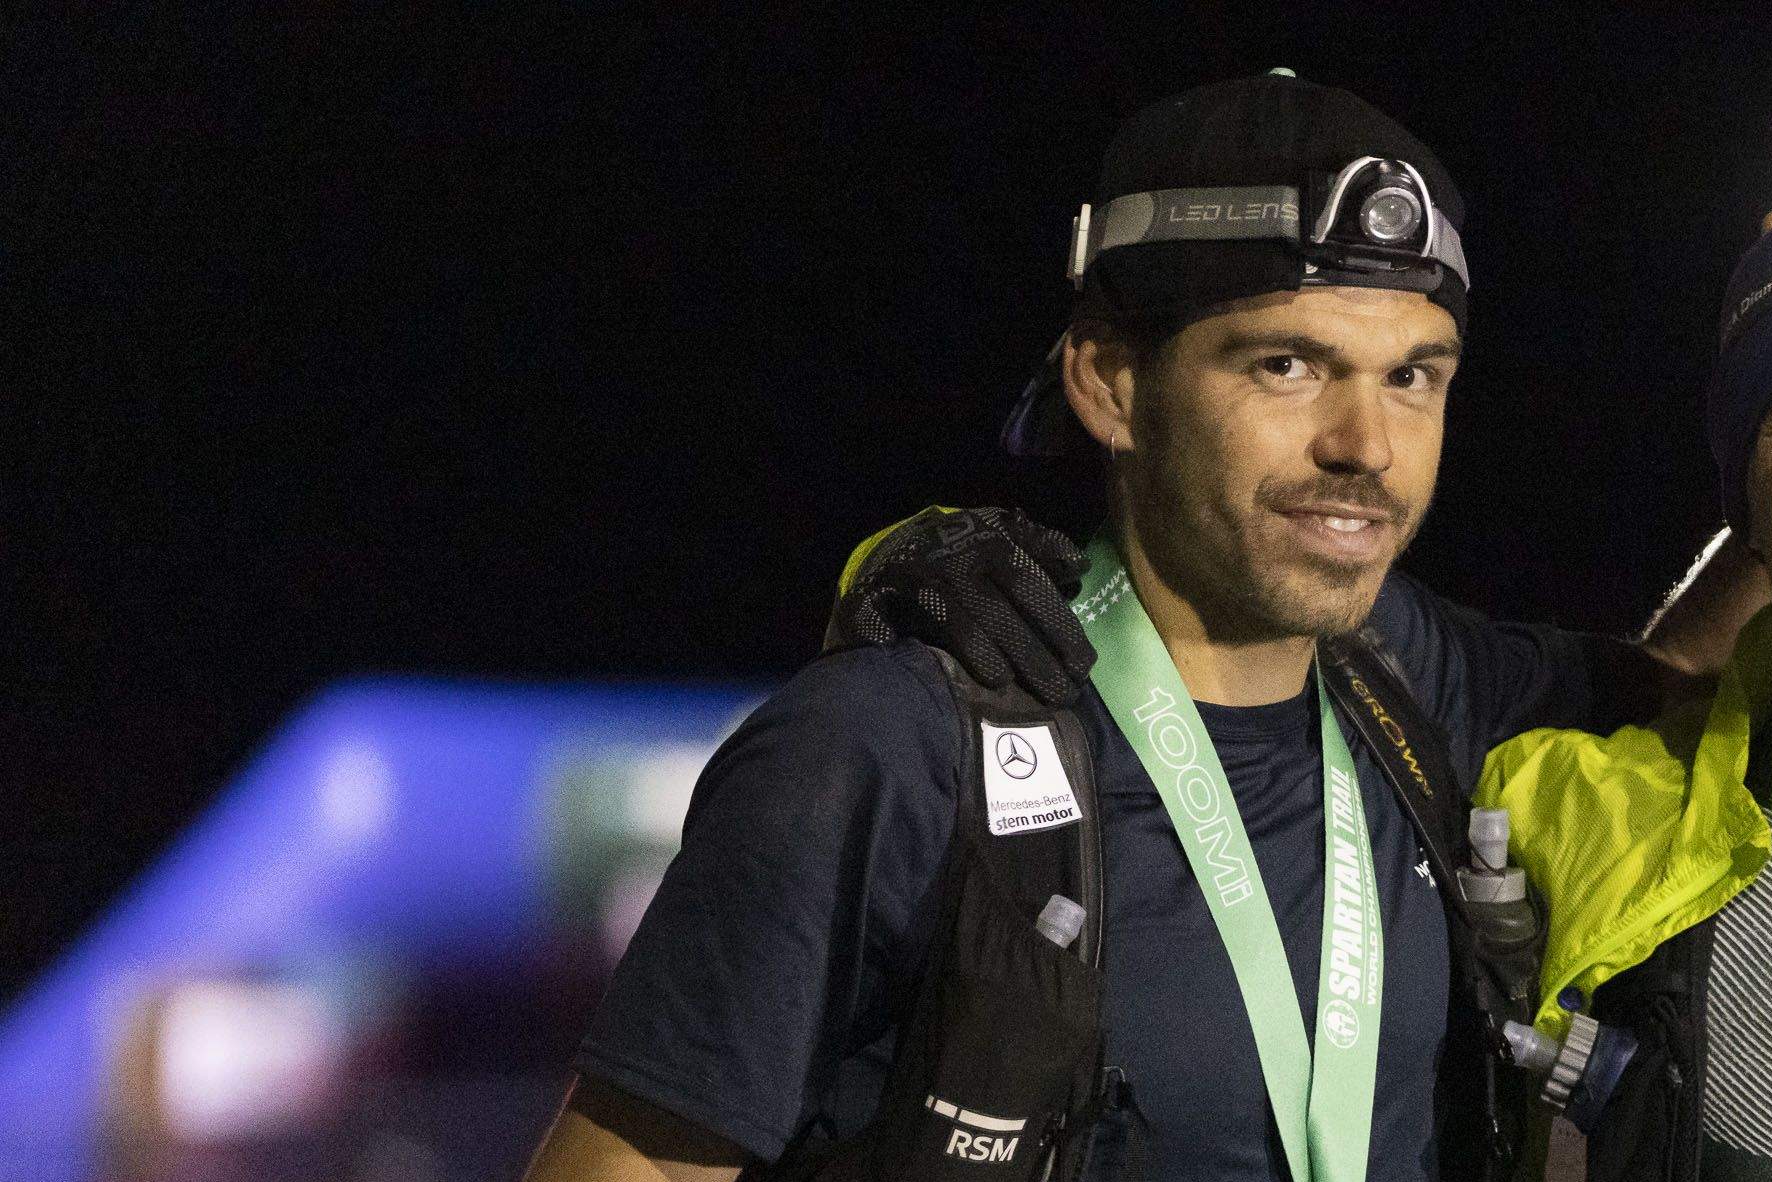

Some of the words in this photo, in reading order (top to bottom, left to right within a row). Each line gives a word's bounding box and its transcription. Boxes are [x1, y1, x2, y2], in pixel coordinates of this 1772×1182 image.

[1169, 203, 1219, 222] LED
[1227, 201, 1299, 221] LENS
[990, 793, 1071, 812] Mercedes-Benz
[1330, 764, 1356, 834] TRAIL
[995, 815, 1030, 831] stern
[1033, 806, 1073, 825] motor
[1328, 834, 1363, 1000] SPARTAN
[1366, 931, 1381, 1006] WORLD
[946, 1128, 1019, 1162] RSM
